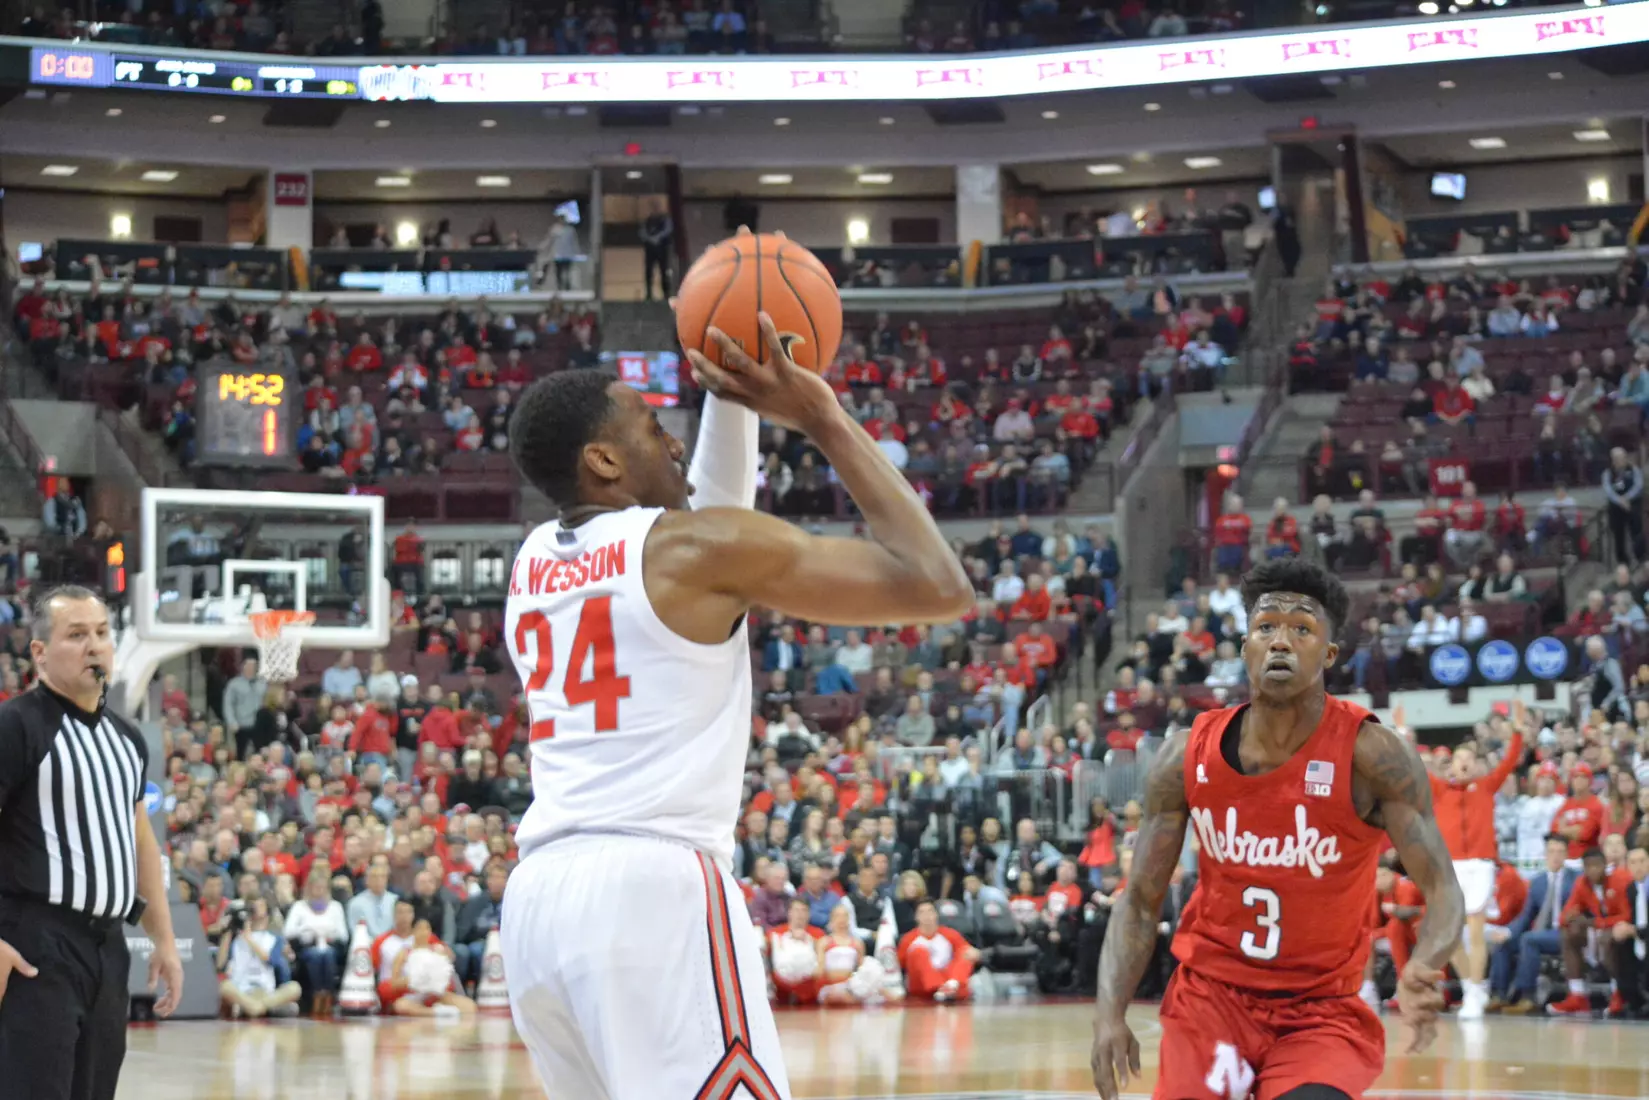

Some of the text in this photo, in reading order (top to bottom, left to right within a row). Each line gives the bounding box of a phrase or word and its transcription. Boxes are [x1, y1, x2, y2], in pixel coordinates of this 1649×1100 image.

[41, 54, 94, 79] 0:00
[219, 373, 284, 406] 14:52
[528, 539, 626, 596] WESSON
[515, 594, 631, 744] 24
[1190, 803, 1342, 879] Nebraska
[1239, 885, 1282, 961] 3
